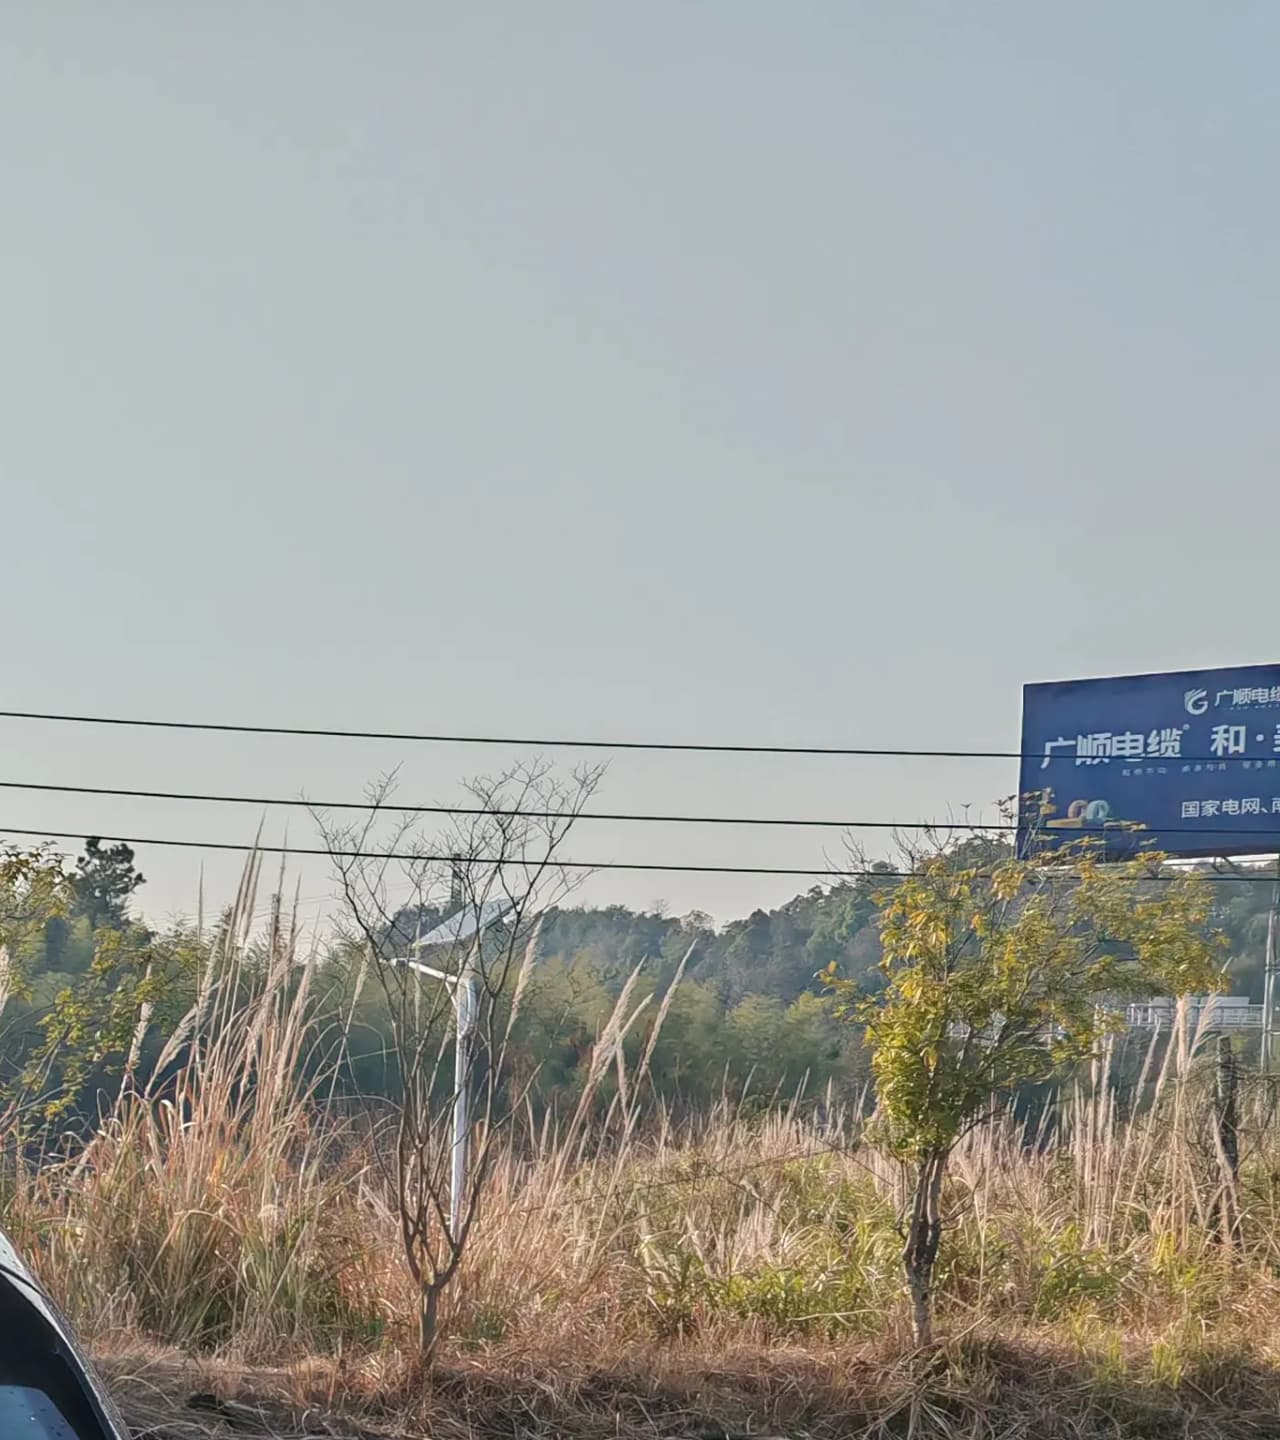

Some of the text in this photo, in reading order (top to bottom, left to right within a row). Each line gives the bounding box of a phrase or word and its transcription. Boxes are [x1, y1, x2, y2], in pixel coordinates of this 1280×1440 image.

[1040, 727, 1184, 769] 广顺电缆
[1210, 724, 1280, 757] 和·
